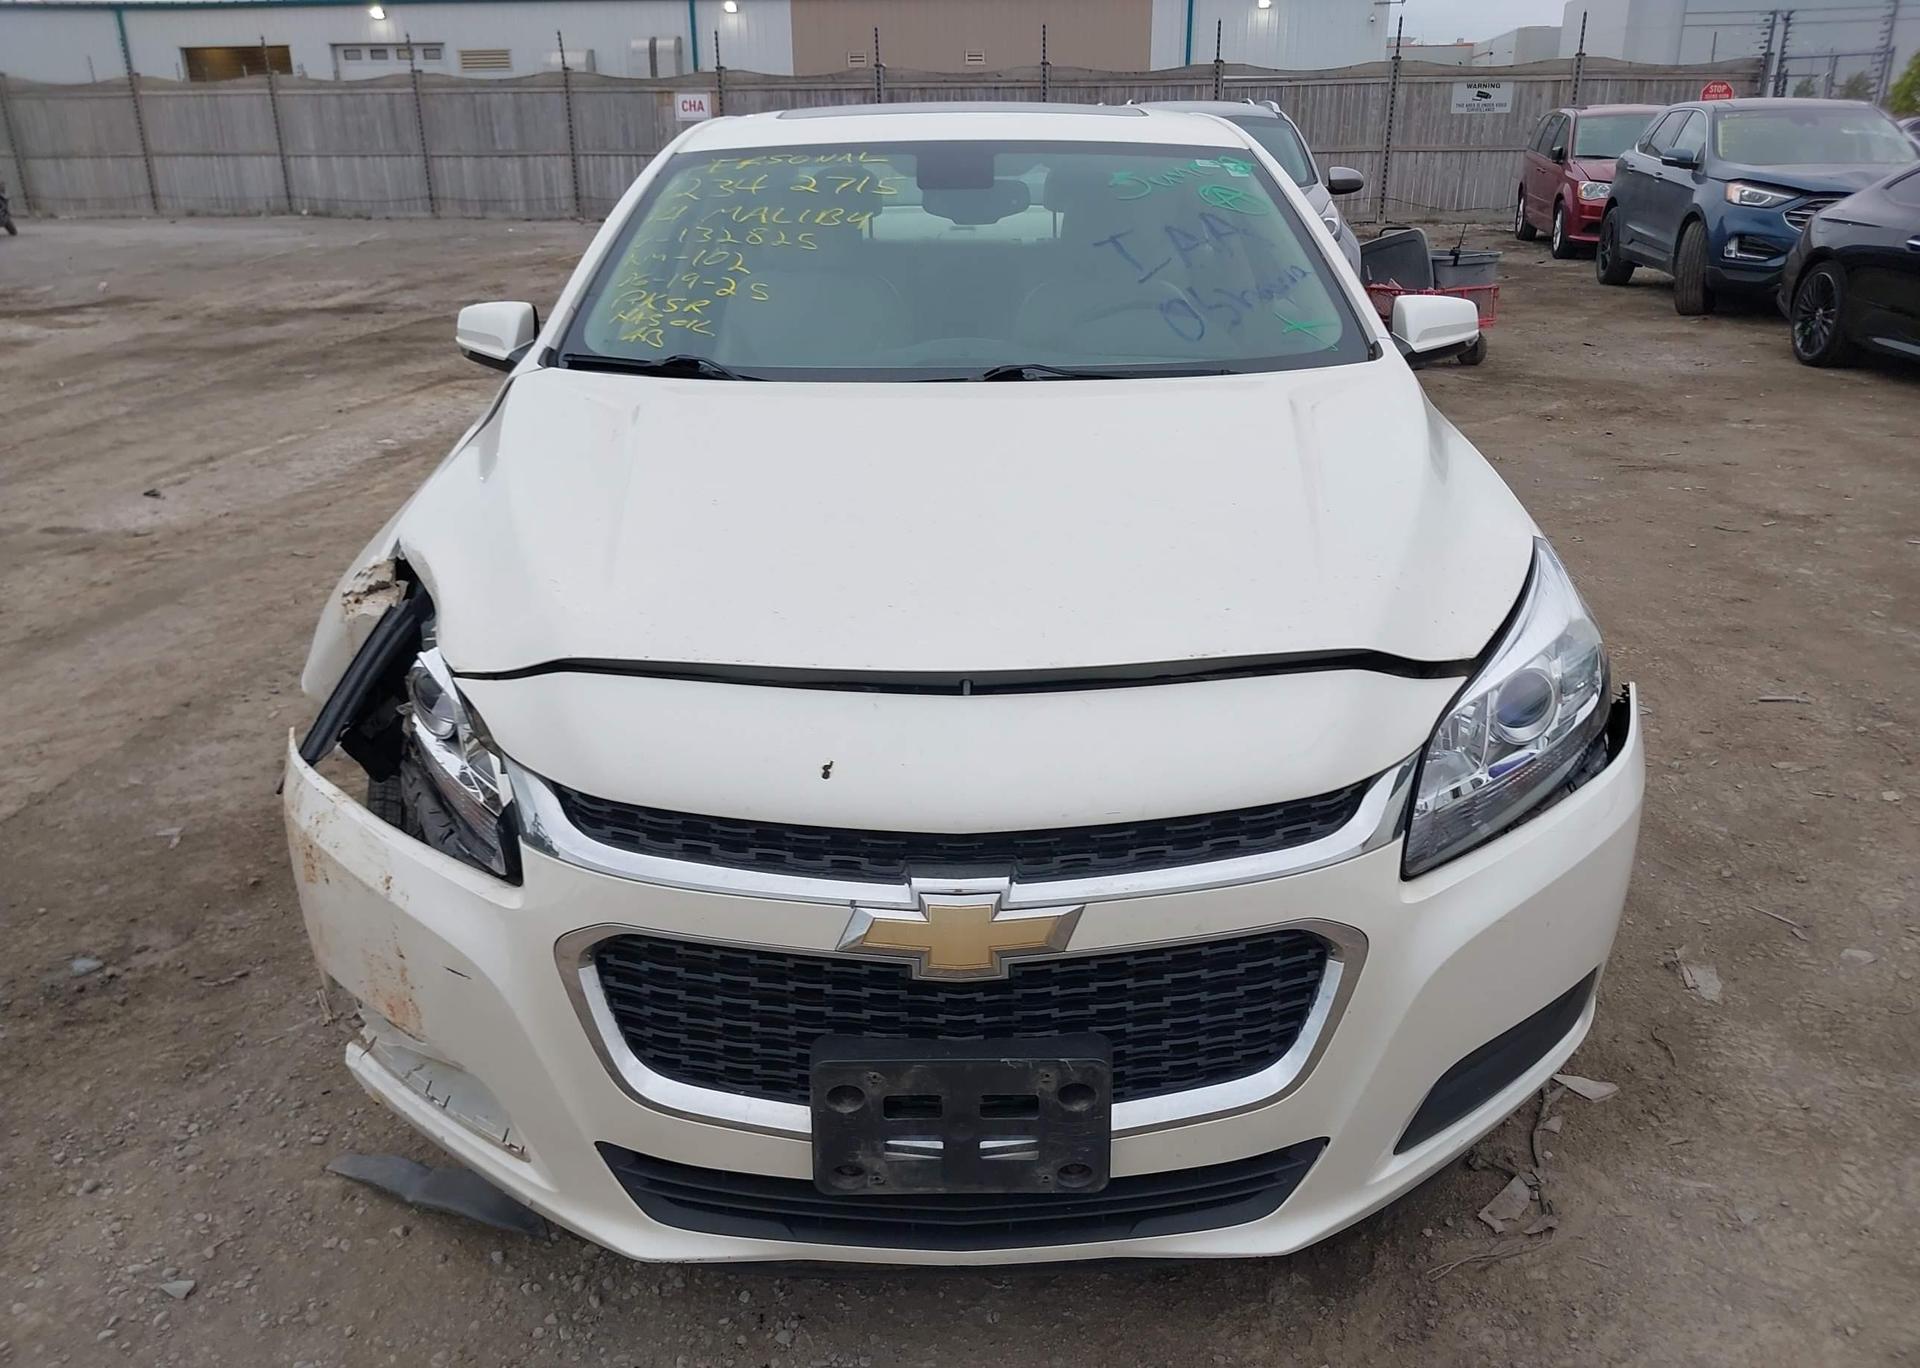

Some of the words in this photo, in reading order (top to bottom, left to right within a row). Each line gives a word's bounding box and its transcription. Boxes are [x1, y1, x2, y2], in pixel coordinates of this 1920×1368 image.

[1709, 84, 1728, 93] STOP
[681, 100, 705, 112] CHA
[789, 174, 907, 196] 2715
